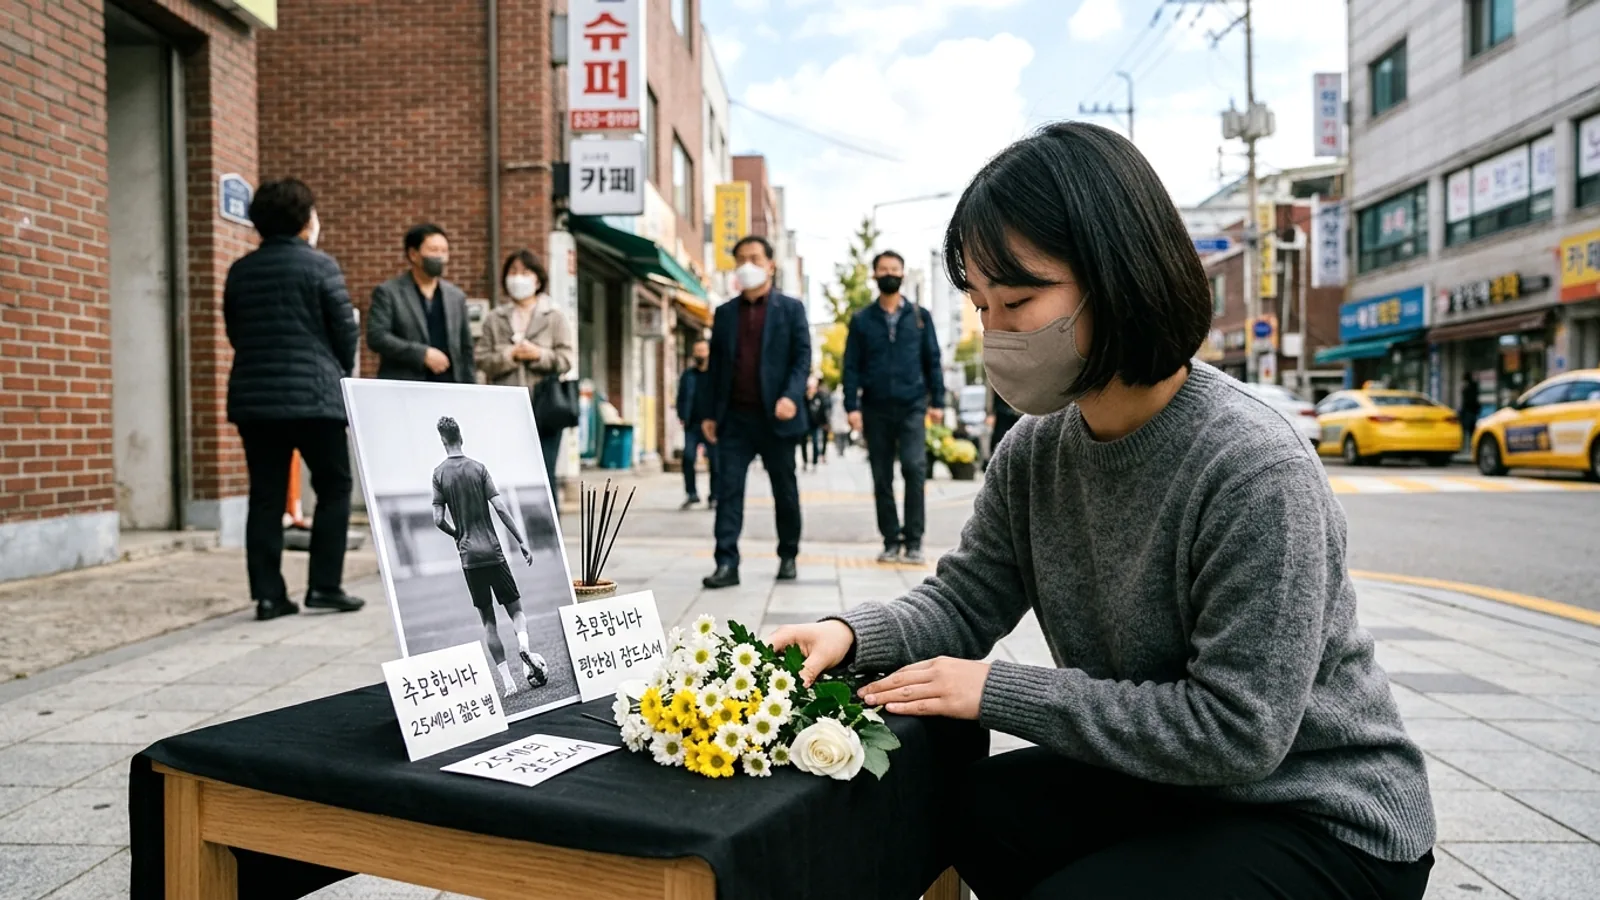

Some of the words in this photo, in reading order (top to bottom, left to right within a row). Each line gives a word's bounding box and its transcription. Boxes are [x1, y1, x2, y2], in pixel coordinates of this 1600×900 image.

[583, 12, 628, 98] 슈퍼
[580, 167, 635, 193] 카페
[402, 663, 478, 706] 추모합니다
[411, 707, 456, 737] 25세의
[456, 699, 481, 723] 젊은
